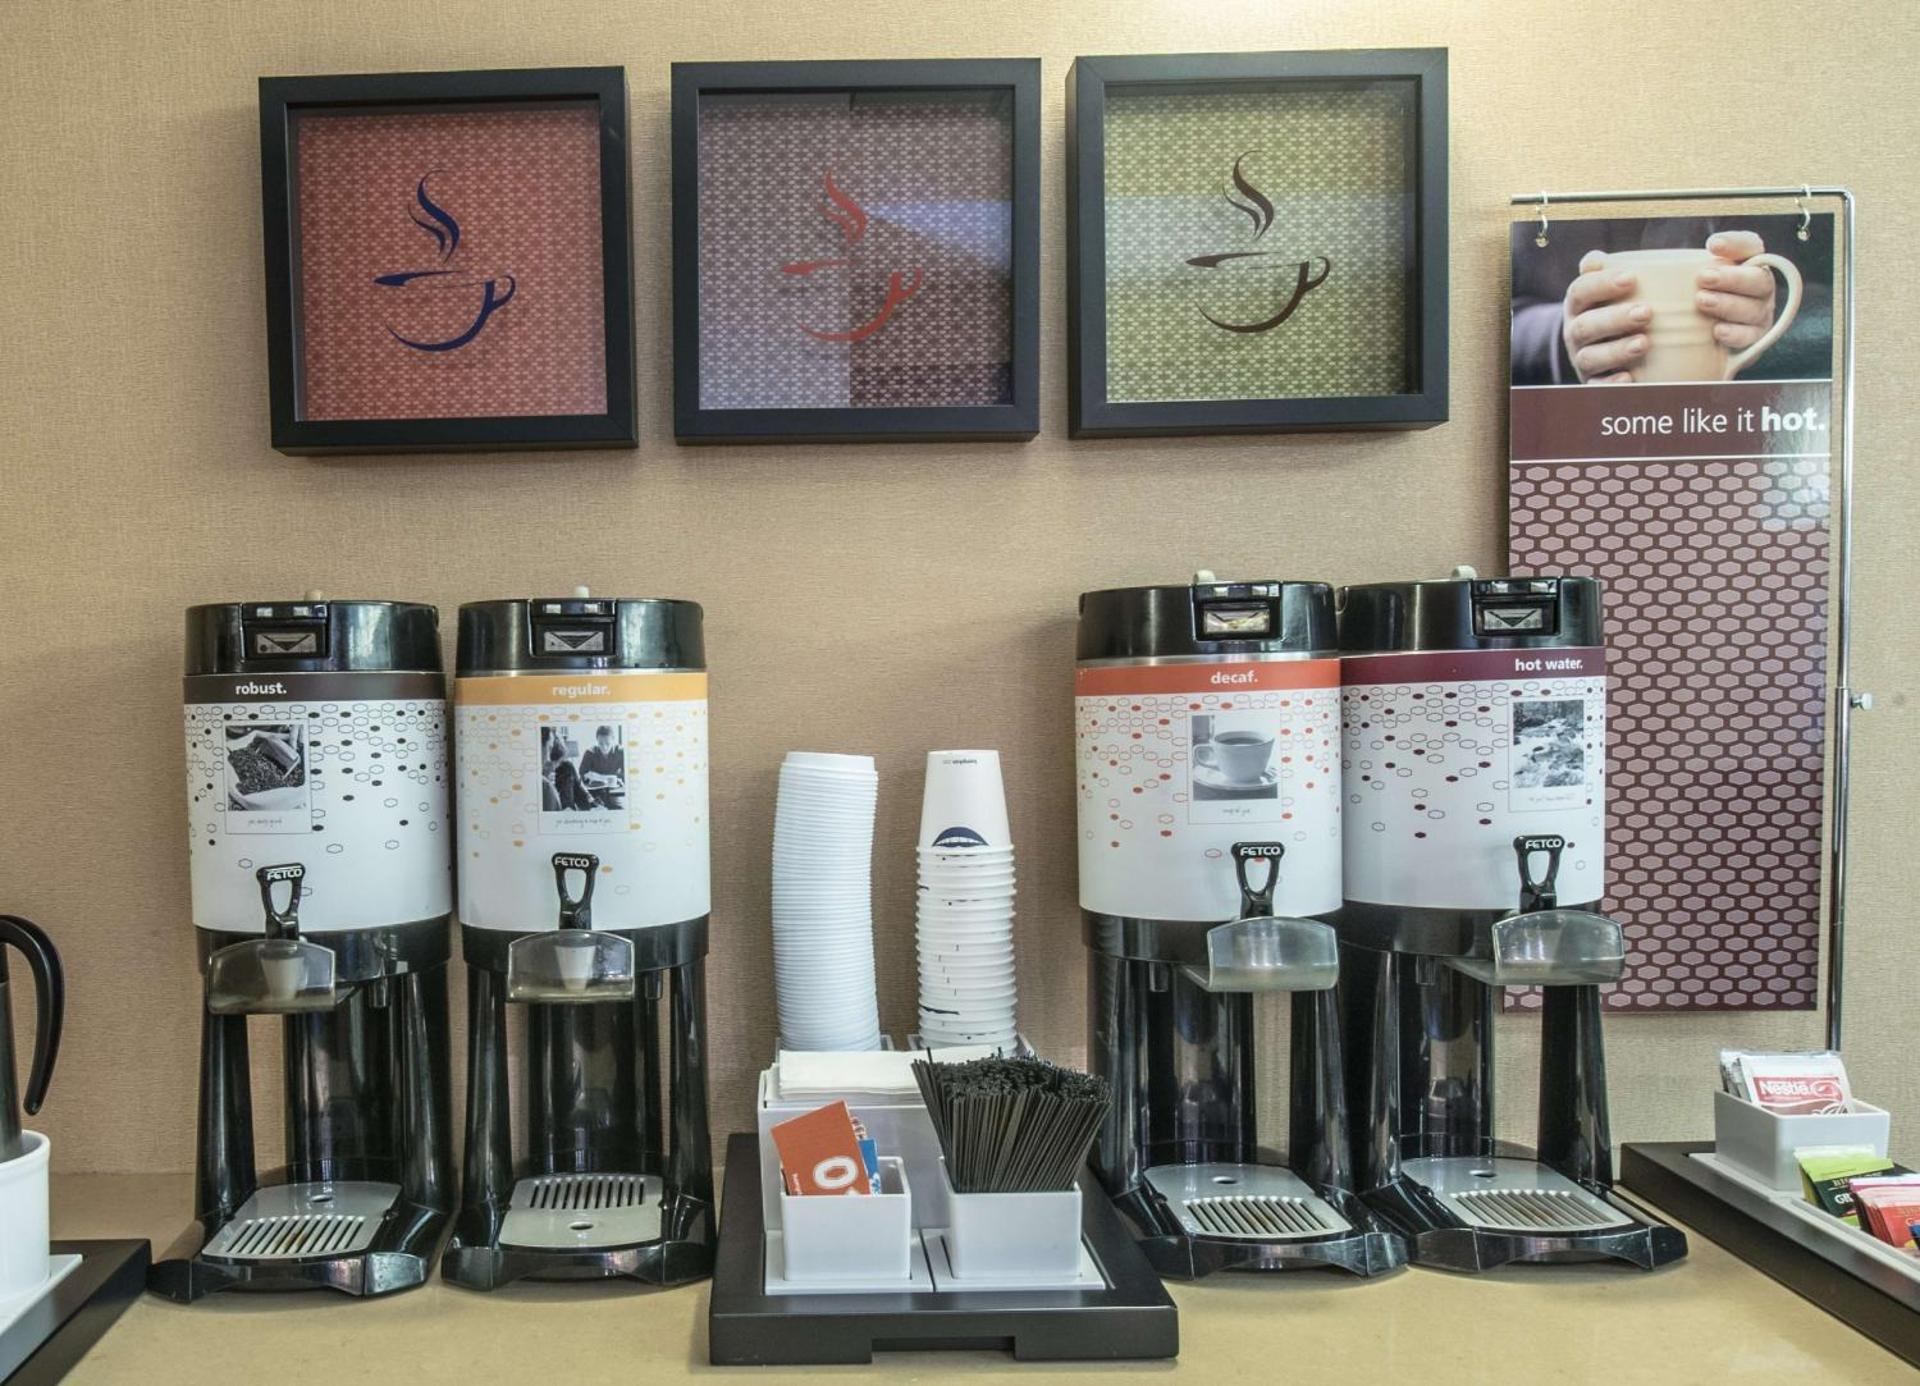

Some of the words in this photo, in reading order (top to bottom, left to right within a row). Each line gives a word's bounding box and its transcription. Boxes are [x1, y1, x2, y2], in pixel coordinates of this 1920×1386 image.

[1600, 414, 1673, 436] some
[1683, 408, 1727, 433] like
[1737, 407, 1756, 432] it
[1761, 406, 1826, 432] hot.
[1514, 658, 1543, 672] hot
[1545, 658, 1584, 672] water.
[1210, 670, 1259, 685] decaf.
[235, 682, 288, 696] robust.
[552, 682, 611, 700] regular.
[1525, 839, 1562, 849] FETCO
[1240, 846, 1281, 857] FETCO
[554, 856, 590, 868] FETCO
[266, 868, 303, 881] FETCO
